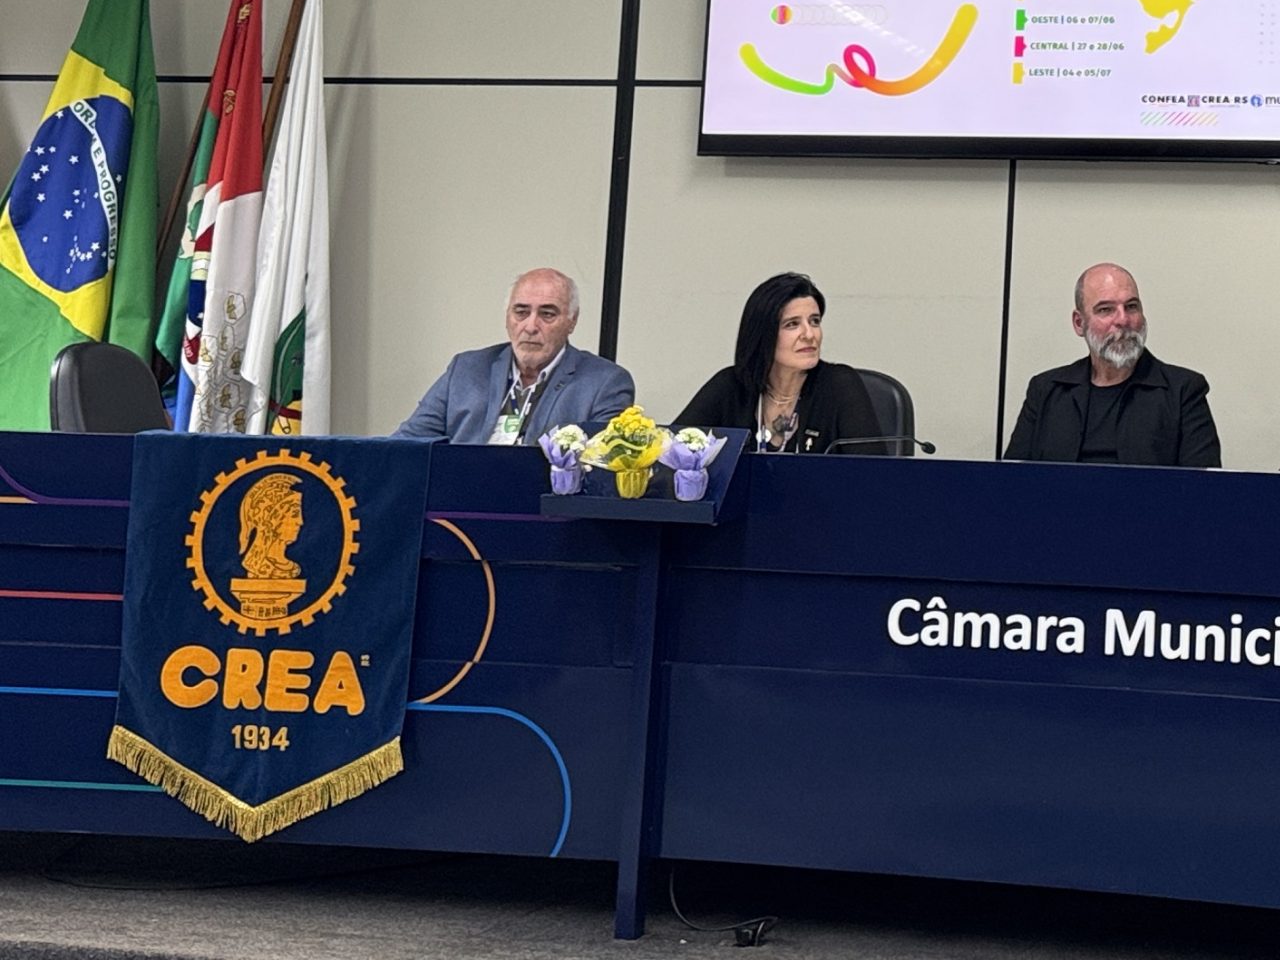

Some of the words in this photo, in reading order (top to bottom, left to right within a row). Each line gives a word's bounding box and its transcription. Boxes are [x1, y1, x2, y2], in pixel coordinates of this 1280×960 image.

[1031, 16, 1059, 24] OESTE
[1066, 16, 1079, 24] 06
[1088, 15, 1115, 24] 07/06
[1030, 42, 1069, 50] CENTRAL
[1077, 42, 1087, 50] 27
[1097, 42, 1125, 51] 28/06
[1028, 68, 1055, 77] LESTE
[1062, 69, 1074, 77] 04
[1084, 68, 1112, 77] 05/07
[1141, 94, 1186, 103] CONFEA
[888, 597, 1085, 654] Câmara
[160, 645, 365, 716] CREA
[231, 724, 290, 752] 1934
